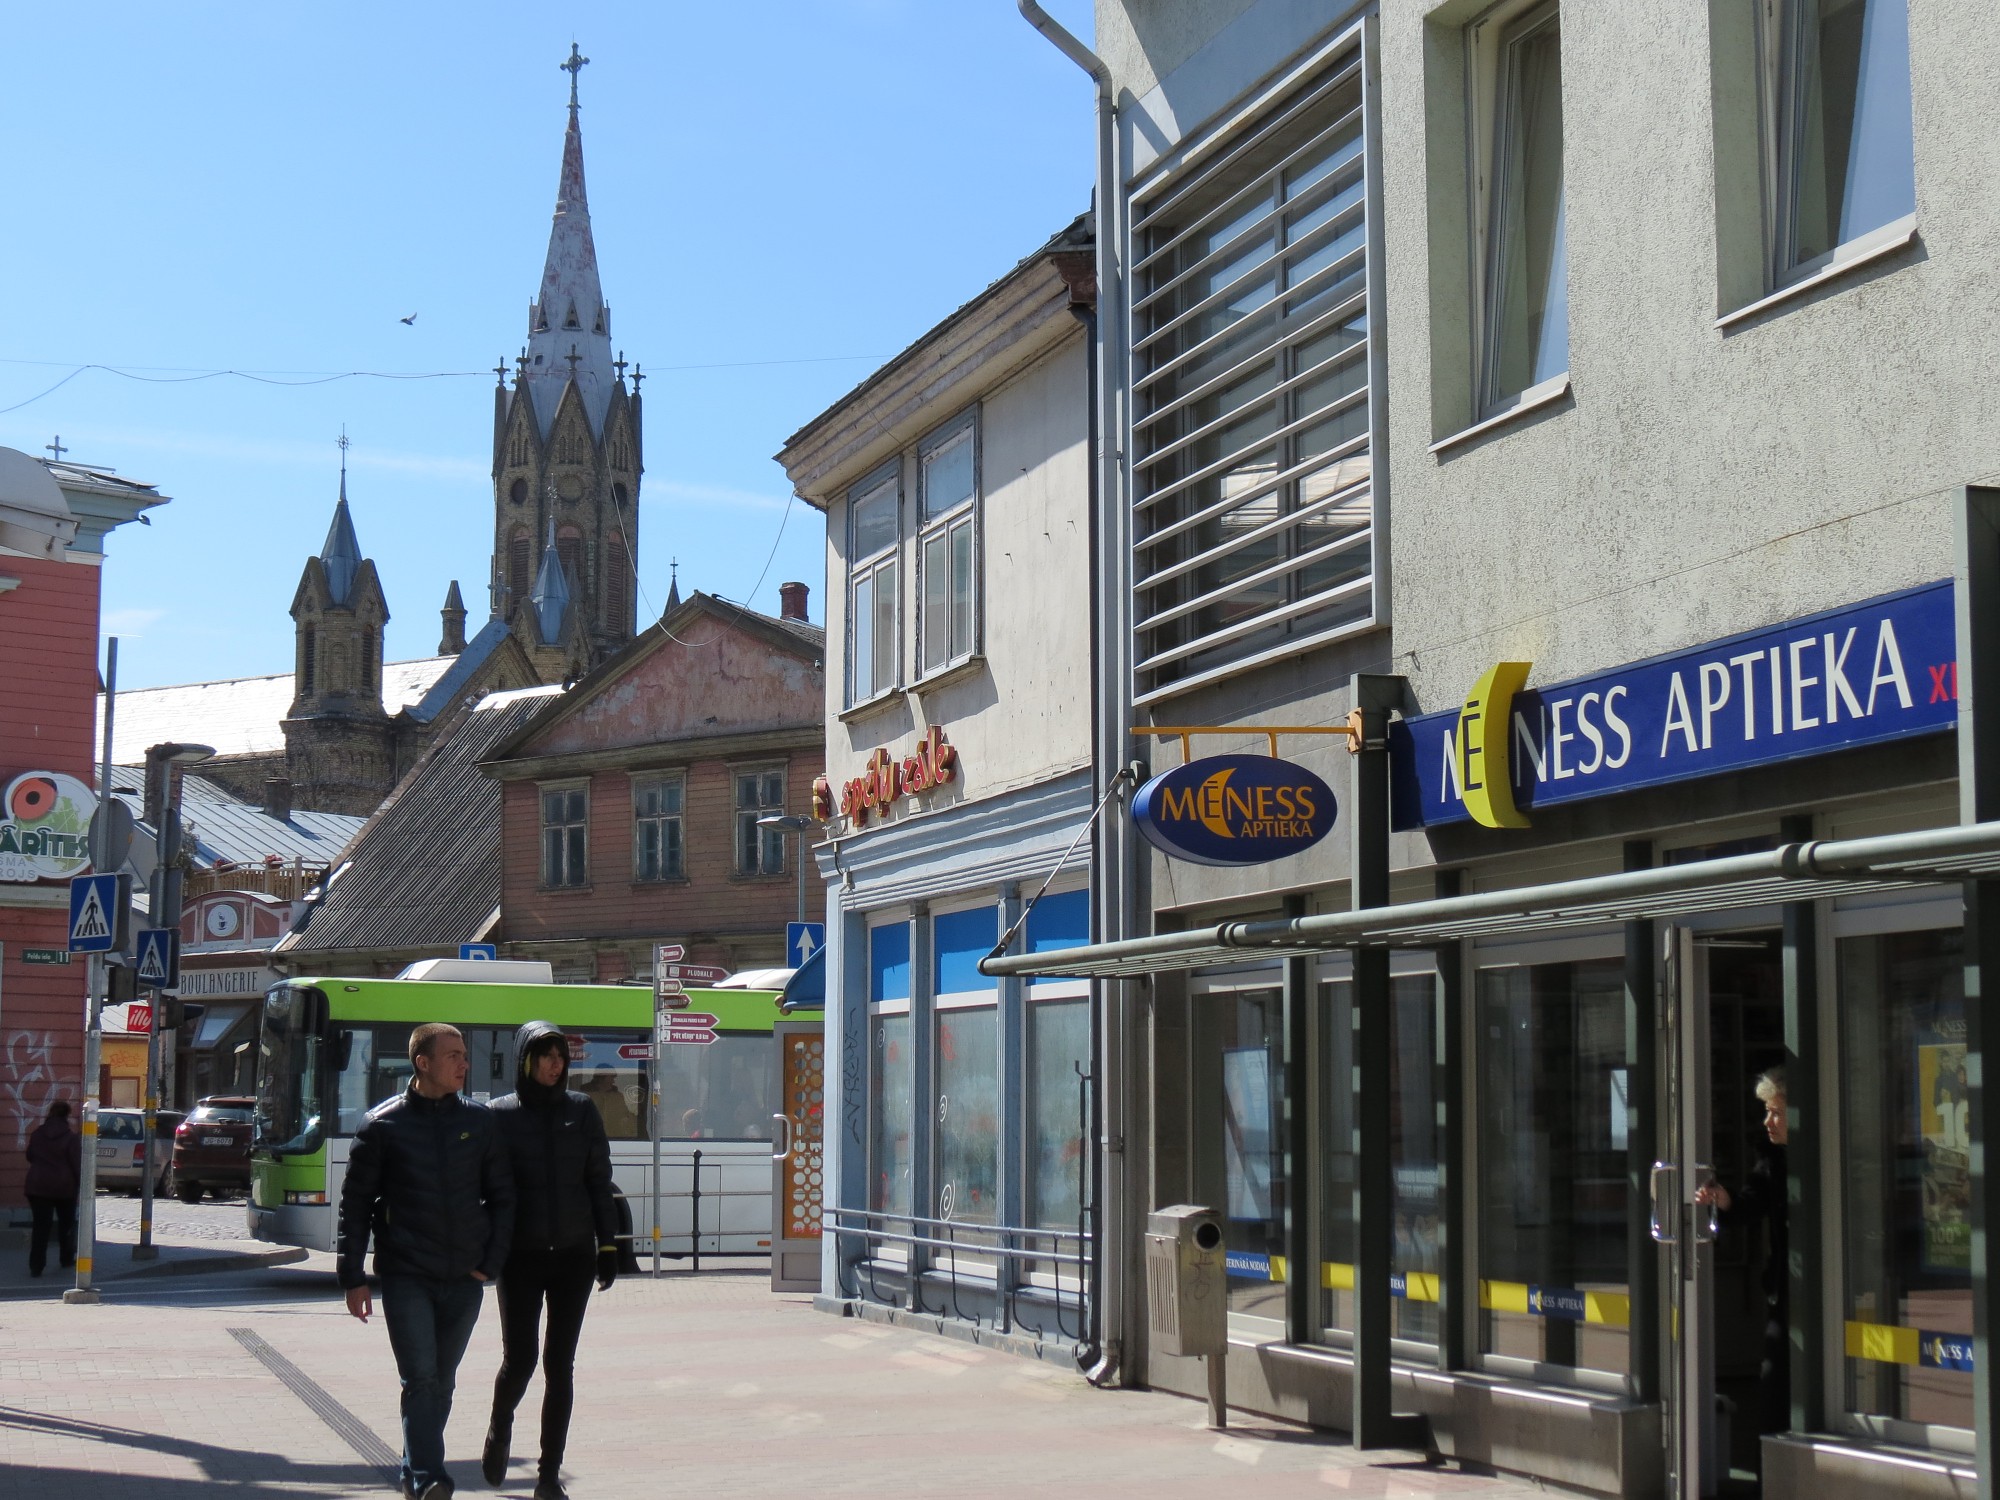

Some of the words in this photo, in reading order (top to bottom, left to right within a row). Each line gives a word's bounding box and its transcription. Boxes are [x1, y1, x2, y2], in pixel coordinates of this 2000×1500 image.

[1660, 618, 1914, 758] APTIEKA
[1160, 780, 1316, 821] MĒNESS
[1240, 820, 1314, 838] APTIEKA
[0, 824, 88, 858] ĀRĪTES
[59, 951, 69, 962] 11
[180, 971, 258, 995] BOULANGERIE
[129, 1008, 152, 1030] illy
[1557, 1296, 1584, 1311] APTIEKA
